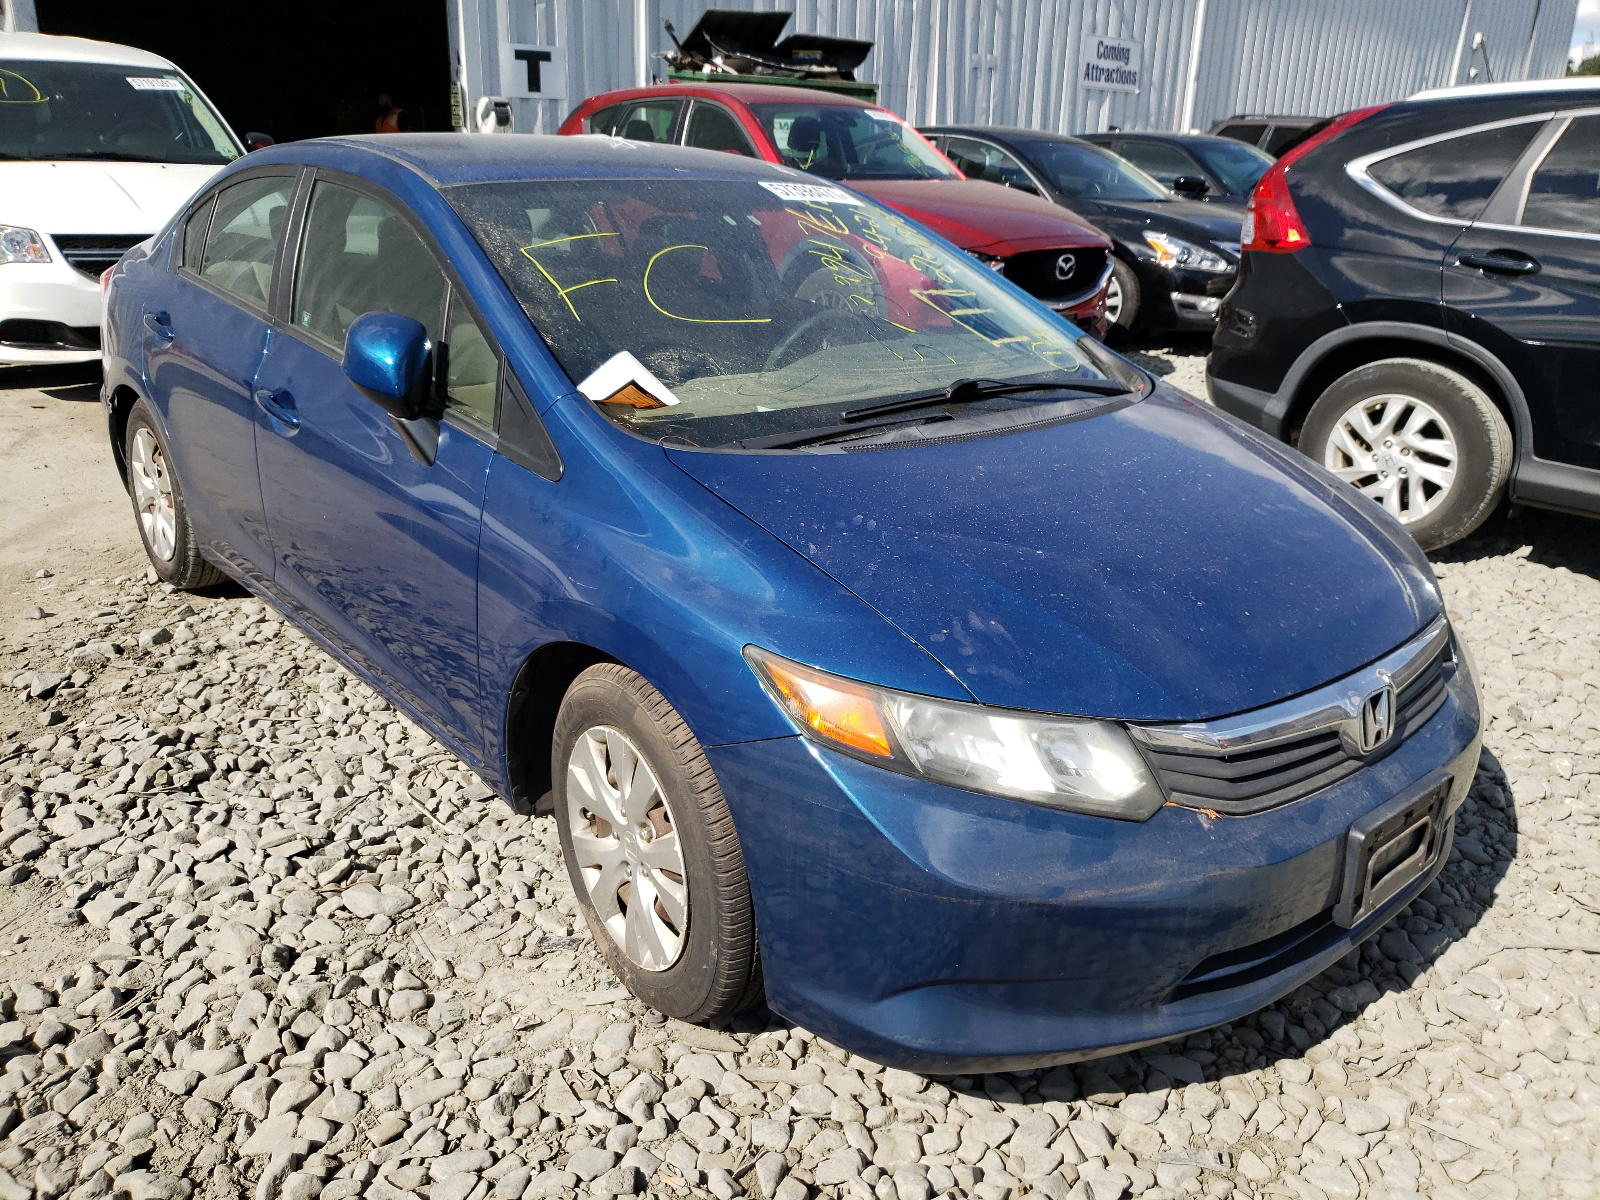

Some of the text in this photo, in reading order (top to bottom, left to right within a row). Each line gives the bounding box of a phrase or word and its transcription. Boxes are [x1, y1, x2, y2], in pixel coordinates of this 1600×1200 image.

[1096, 39, 1131, 66] Coming
[514, 48, 552, 93] T
[1083, 61, 1138, 86] Attractions
